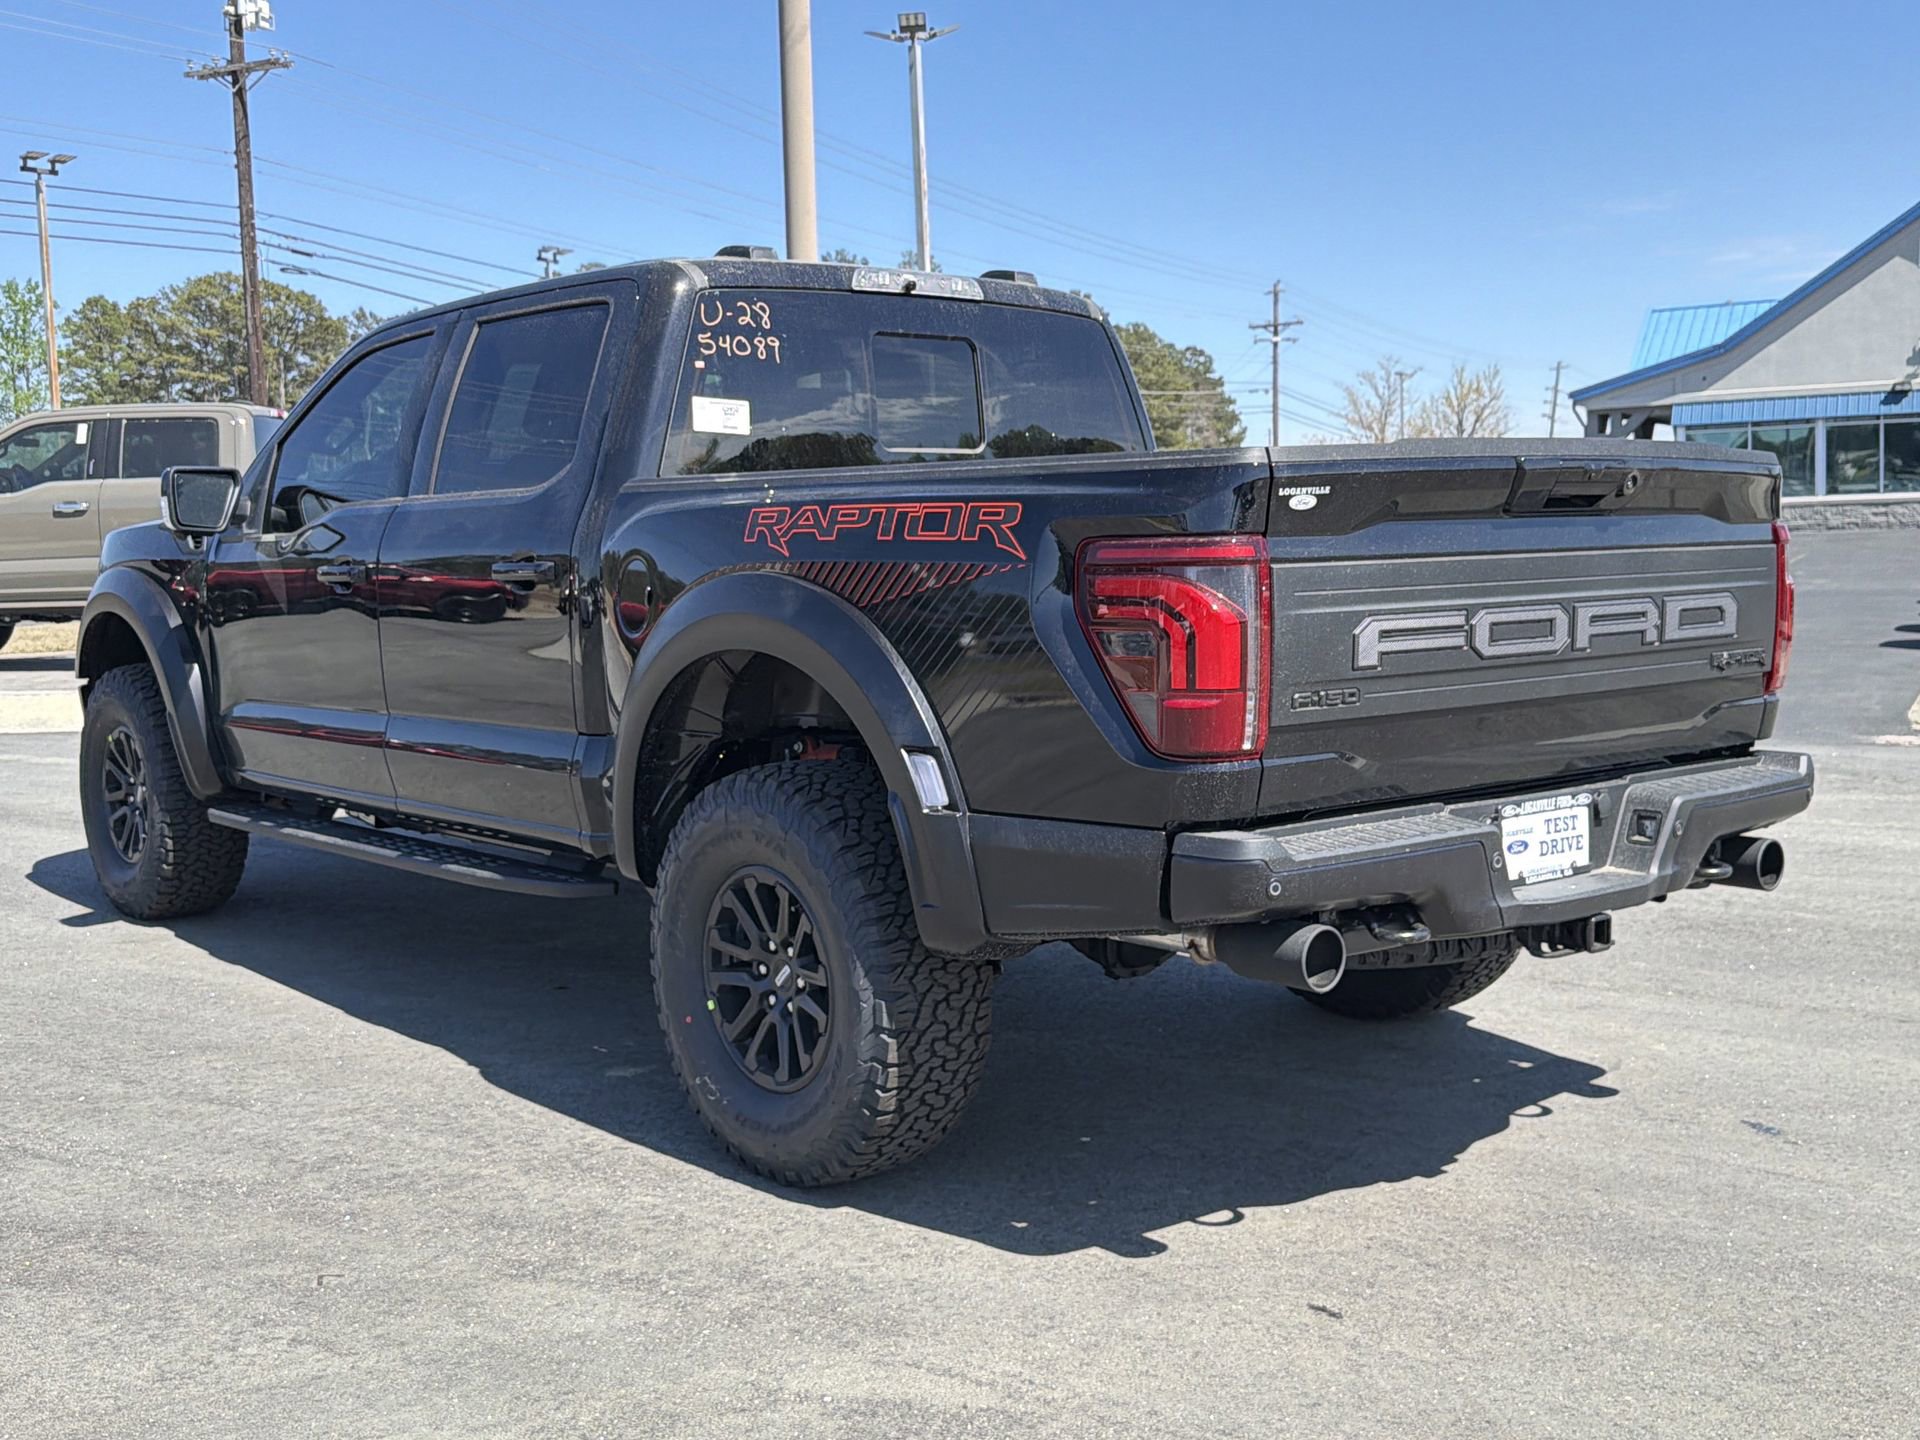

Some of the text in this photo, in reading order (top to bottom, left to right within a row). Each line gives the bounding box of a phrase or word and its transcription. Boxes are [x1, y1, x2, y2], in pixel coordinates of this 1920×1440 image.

[700, 300, 771, 330] U-28
[697, 332, 781, 364] 54089
[1278, 486, 1331, 496] LOGANVILLE
[743, 502, 1027, 561] RAPTOR
[1352, 590, 1740, 671] FORD
[1543, 815, 1578, 835] TEST
[1538, 834, 1584, 857] DRIVE
